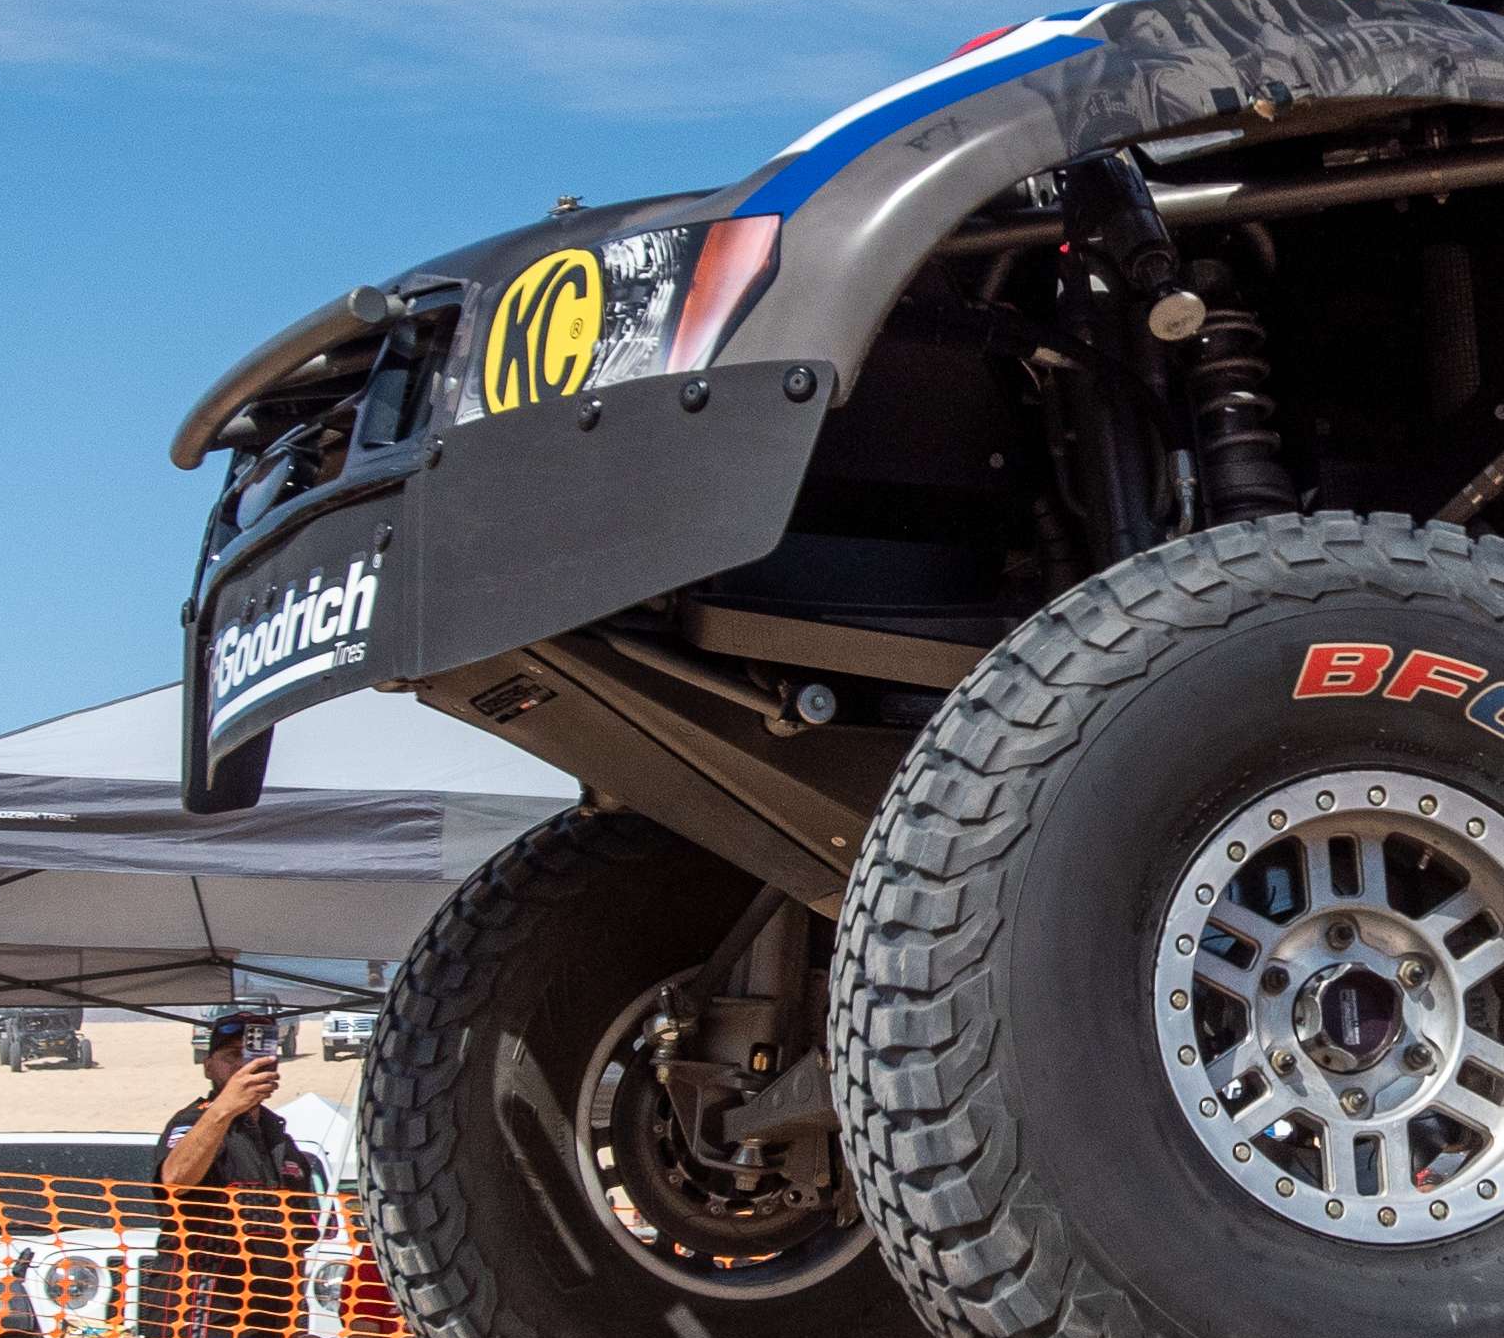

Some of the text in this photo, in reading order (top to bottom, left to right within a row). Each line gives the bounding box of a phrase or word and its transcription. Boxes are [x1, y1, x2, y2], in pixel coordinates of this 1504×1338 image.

[496, 258, 588, 408] KC
[213, 560, 379, 699] Goodrich
[333, 641, 367, 667] Tires
